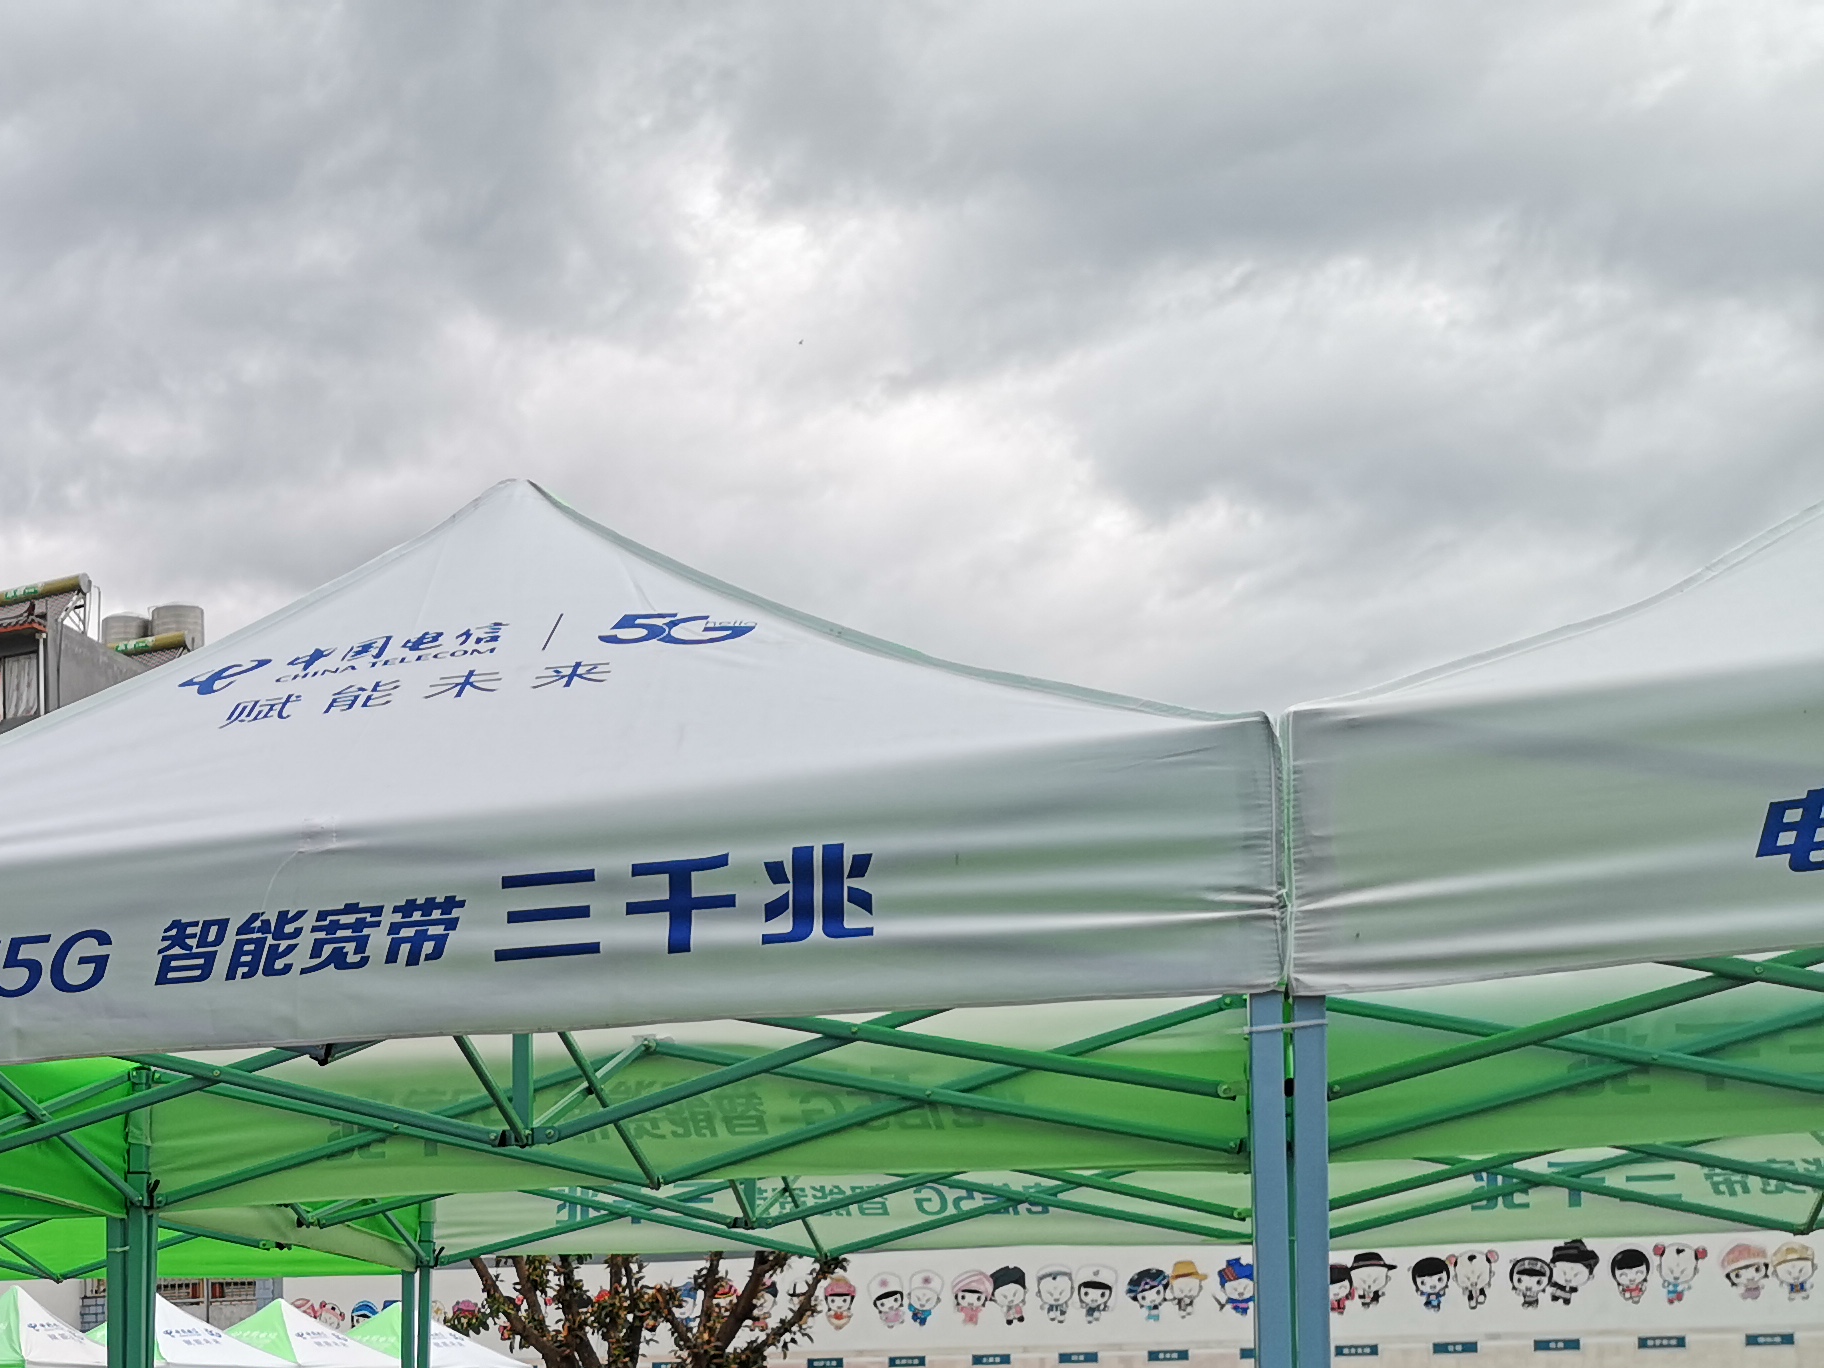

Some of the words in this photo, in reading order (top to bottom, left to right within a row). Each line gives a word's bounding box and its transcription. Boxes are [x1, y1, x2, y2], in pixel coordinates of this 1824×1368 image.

[275, 665, 358, 683] CHINA
[369, 647, 497, 669] TELECOM
[286, 622, 510, 672] 中国电信
[597, 612, 758, 646] 5G
[218, 661, 612, 729] 赋能未来
[154, 895, 467, 986] 智能宽带
[494, 842, 874, 962] 三千兆
